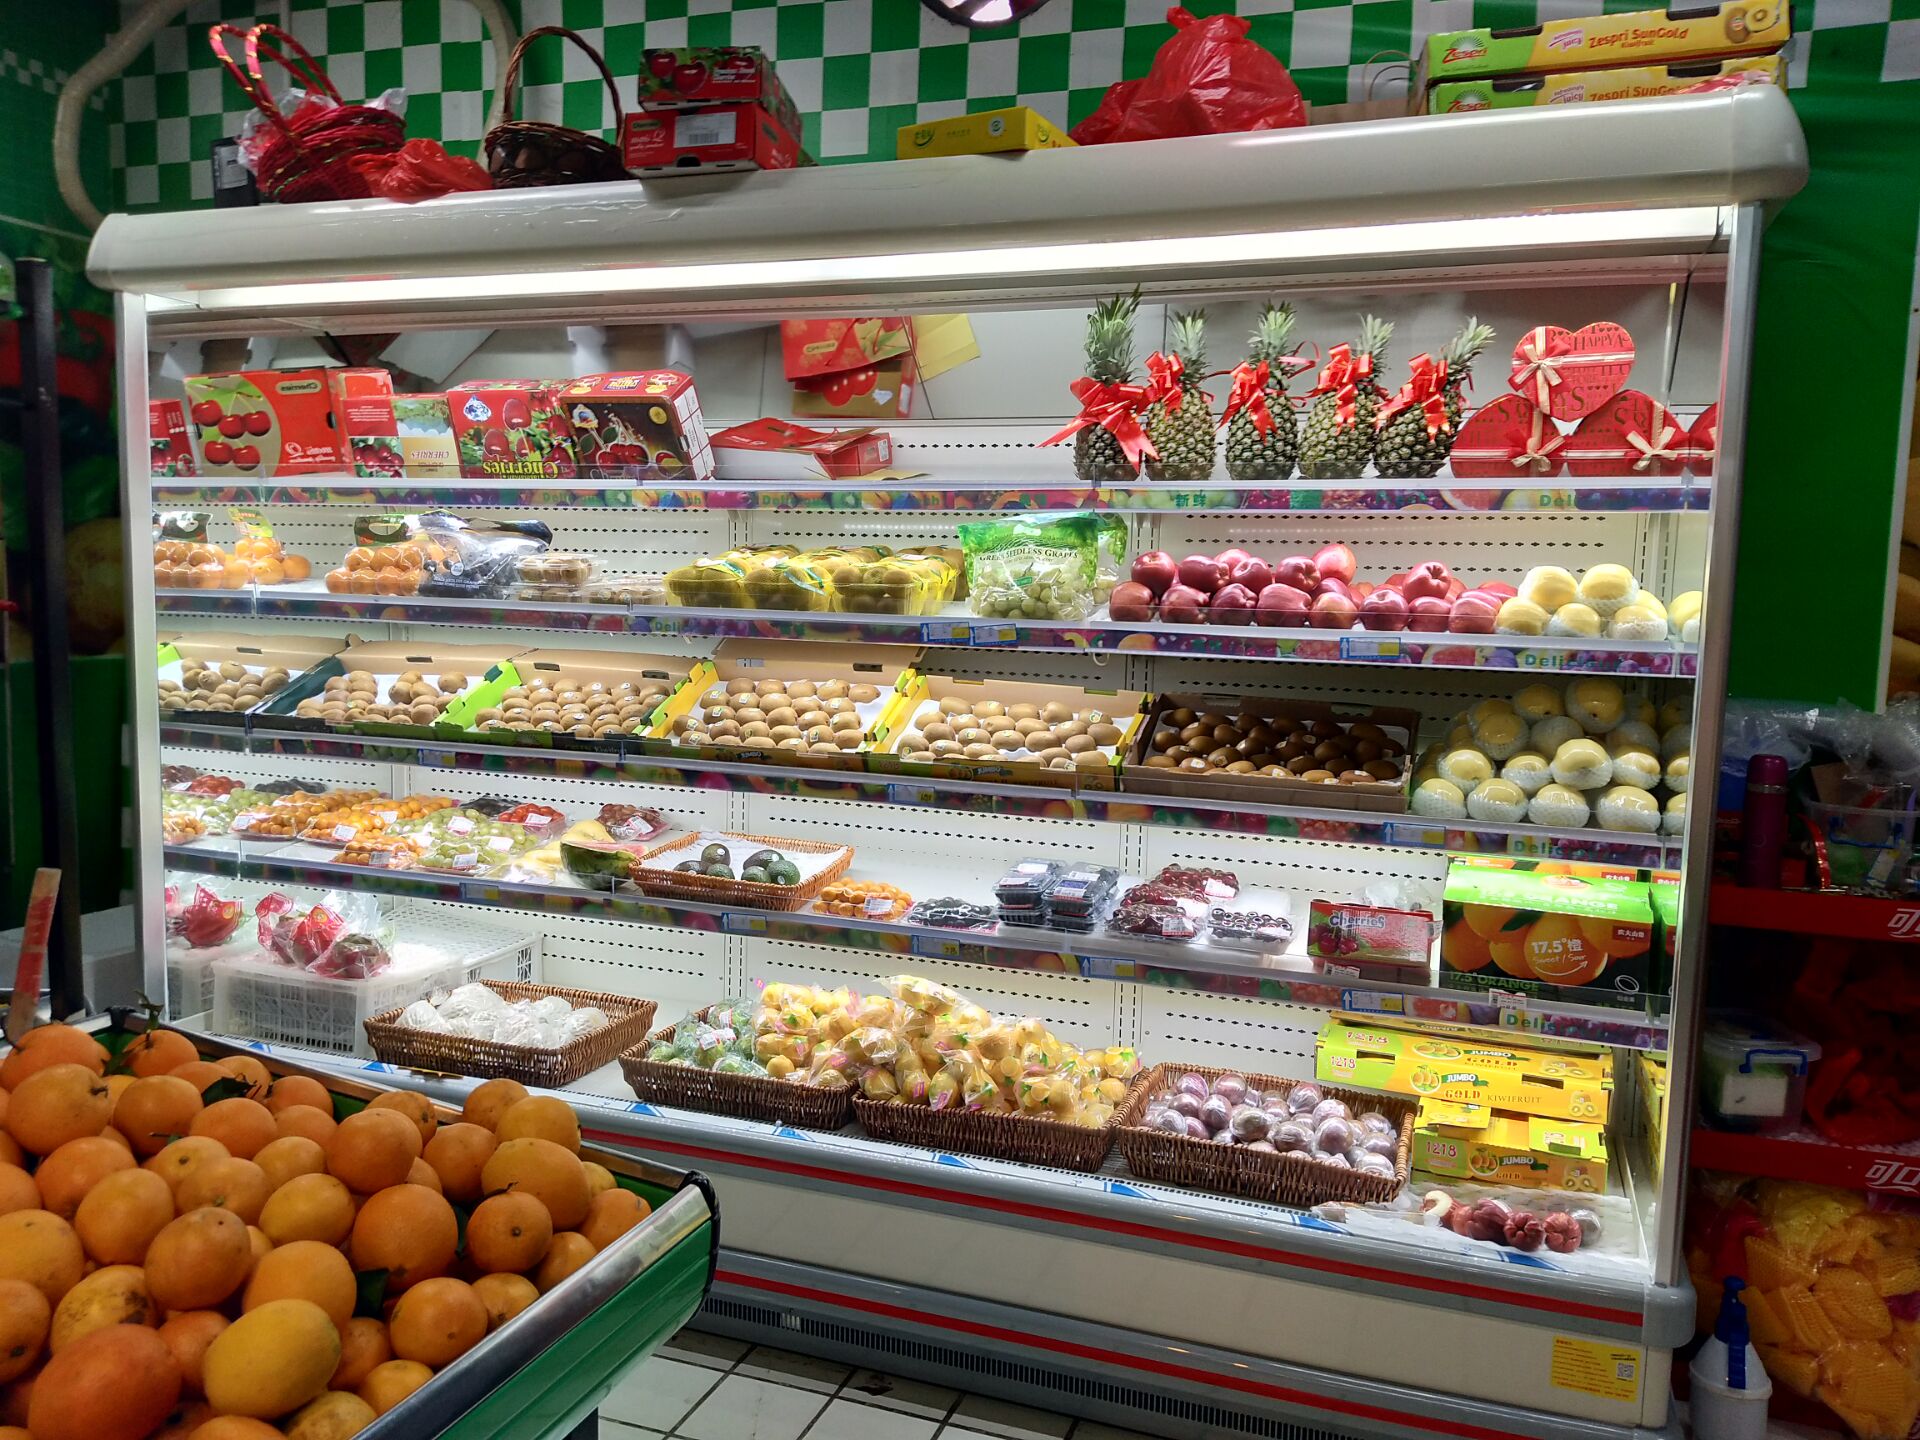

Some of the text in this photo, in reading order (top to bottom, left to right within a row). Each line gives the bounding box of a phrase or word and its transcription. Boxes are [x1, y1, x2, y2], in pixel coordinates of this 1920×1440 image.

[1589, 29, 1630, 48] Zespri
[1632, 27, 1690, 43] SunGold
[1442, 48, 1488, 64] Zespri
[482, 461, 559, 479] Cherries
[1006, 546, 1042, 559] SEEDLESS
[1478, 974, 1541, 992] ORANGE
[1471, 1049, 1512, 1058] JUMBO
[1331, 1055, 1356, 1069] 1218
[1447, 1073, 1477, 1083] JUMBO
[1445, 1089, 1542, 1104] GOLD KIWIFRUIT
[1426, 1140, 1458, 1158] 1218
[1502, 1156, 1535, 1166] JUMBO
[1865, 1159, 1920, 1187] 可口
